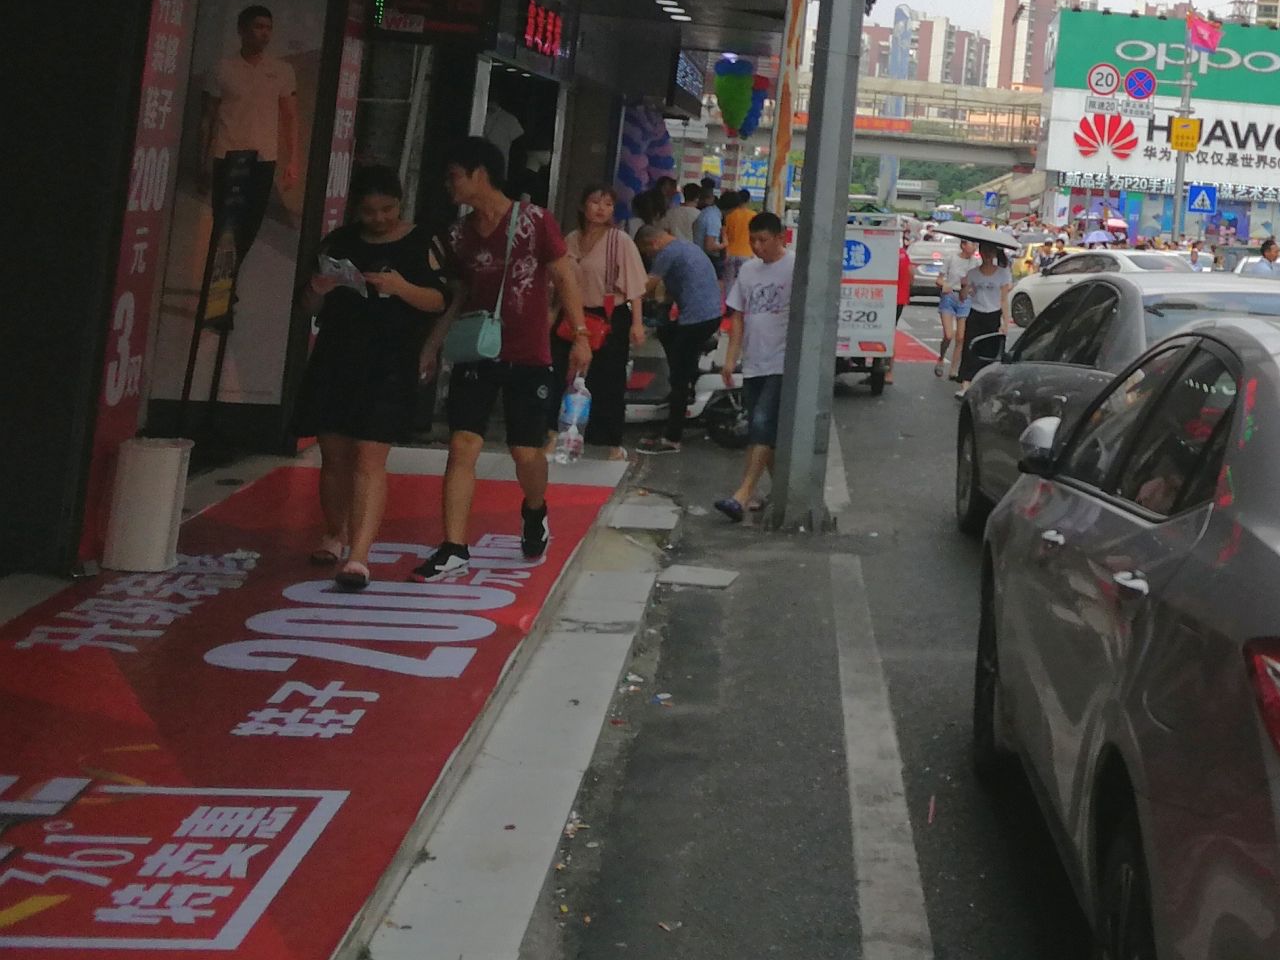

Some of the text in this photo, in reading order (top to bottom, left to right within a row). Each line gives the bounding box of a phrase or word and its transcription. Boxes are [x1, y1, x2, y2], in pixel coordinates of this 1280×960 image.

[1094, 72, 1115, 88] 20
[203, 578, 517, 680] 200
[229, 680, 381, 740] 鞋子
